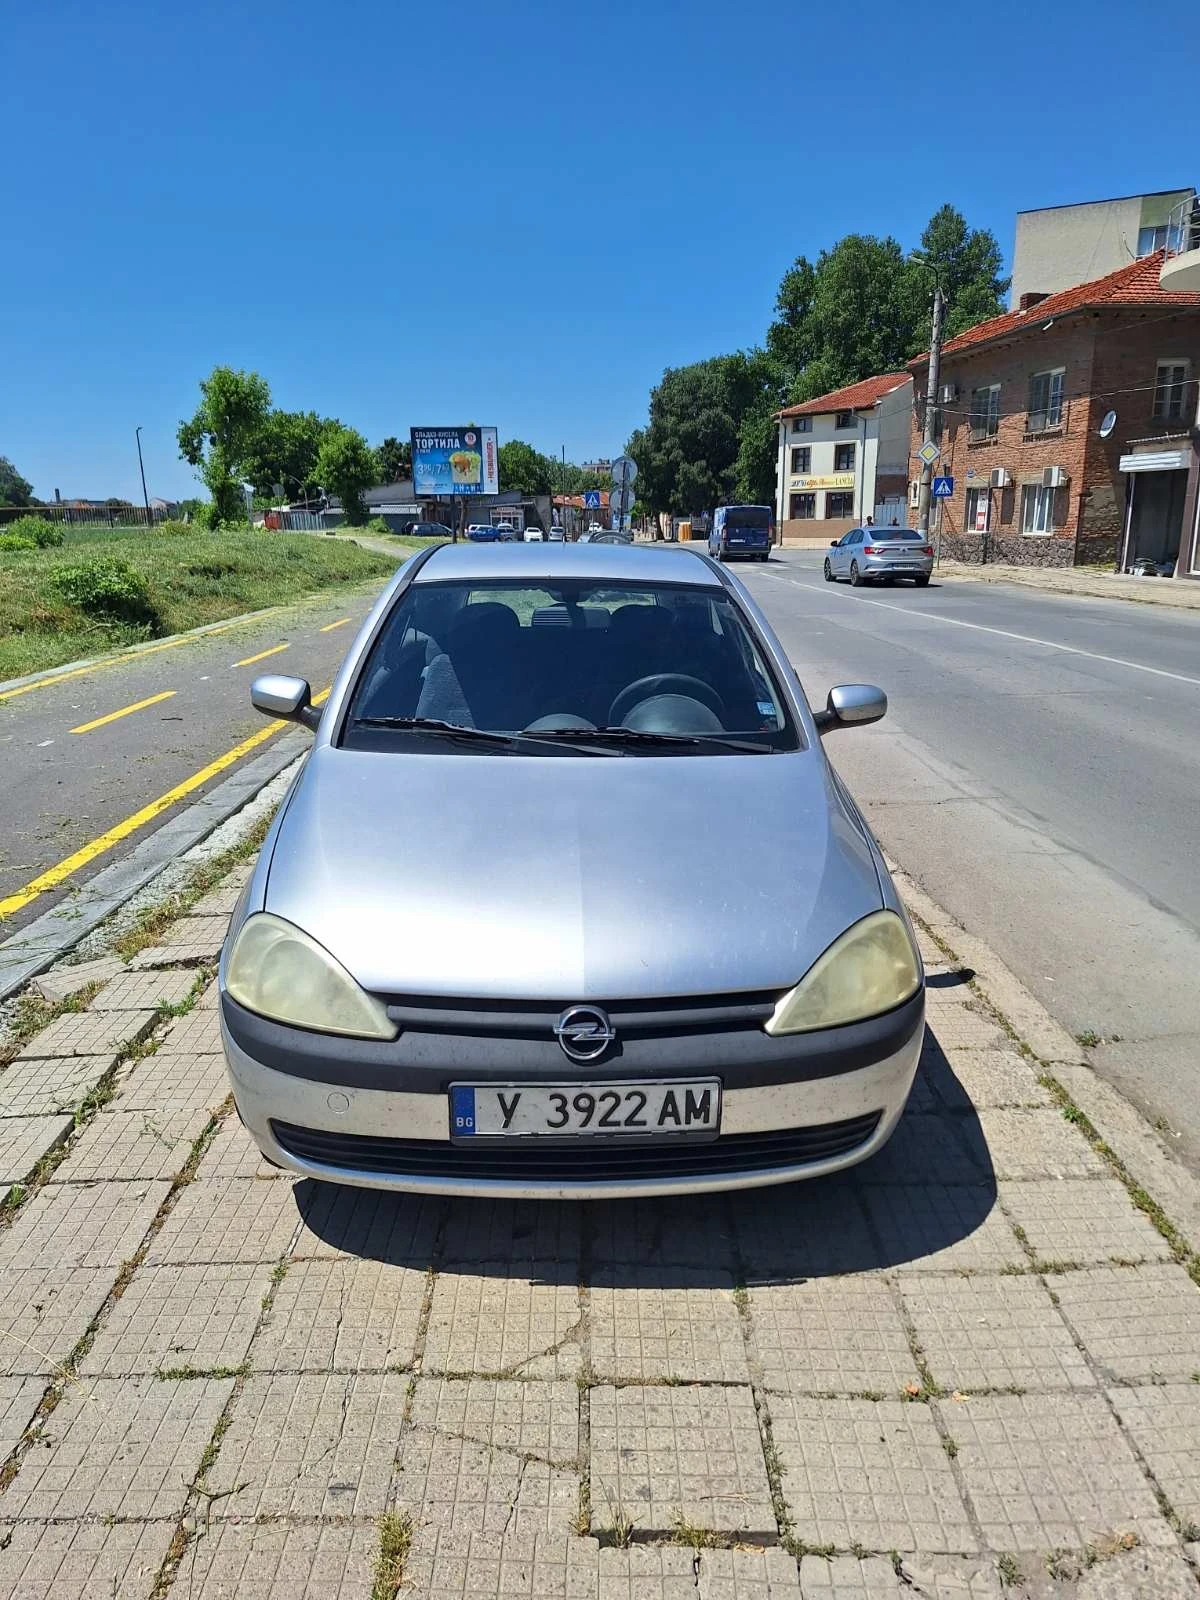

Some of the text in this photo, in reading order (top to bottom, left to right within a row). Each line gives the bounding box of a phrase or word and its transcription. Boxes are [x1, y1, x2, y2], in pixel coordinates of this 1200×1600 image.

[416, 438, 460, 449] ТОРТИЛА
[487, 441, 495, 479] HESBURGER
[546, 1090, 647, 1128] 3922
[456, 1117, 474, 1128] BG
